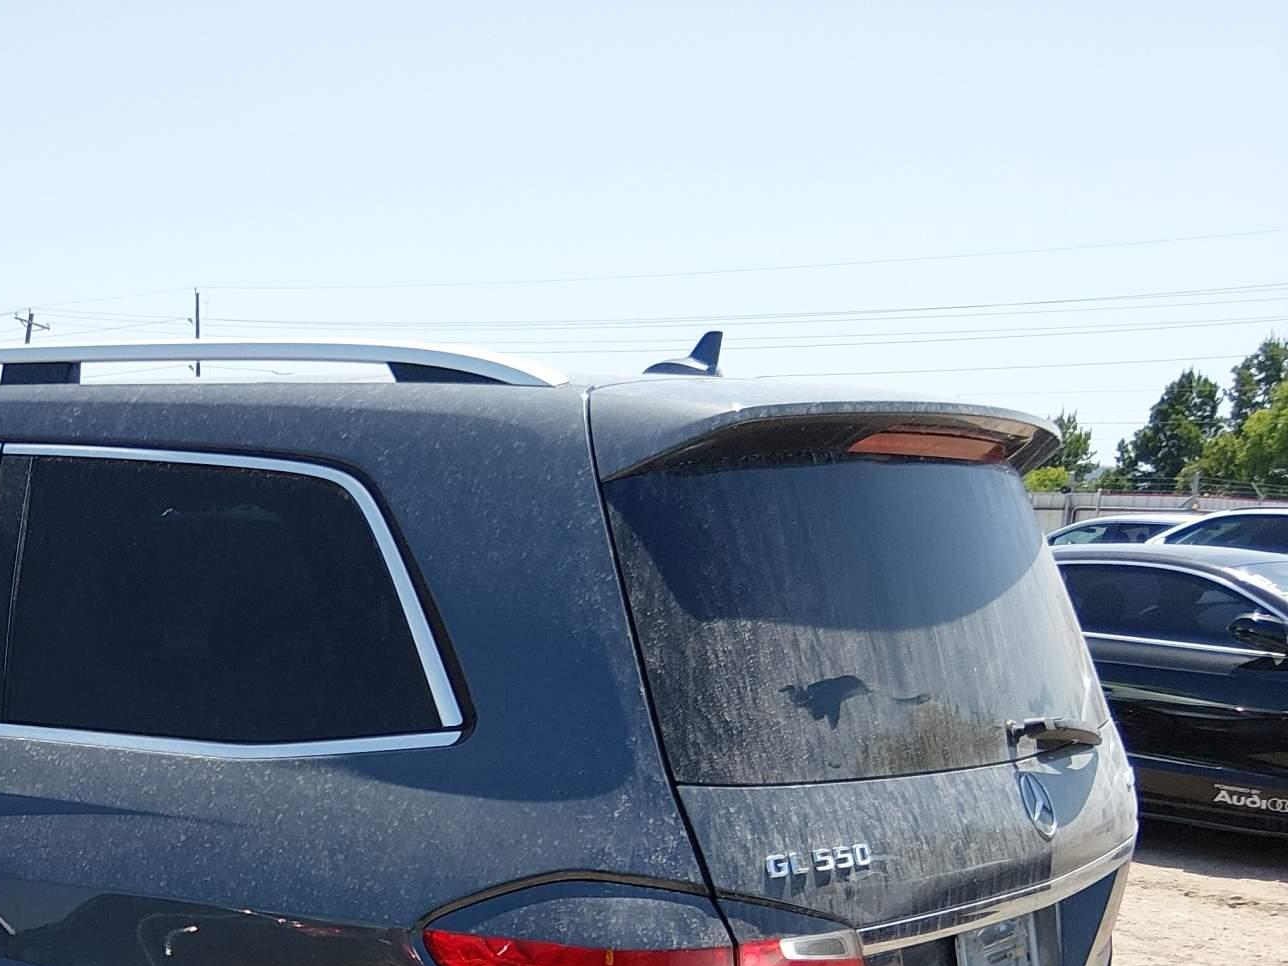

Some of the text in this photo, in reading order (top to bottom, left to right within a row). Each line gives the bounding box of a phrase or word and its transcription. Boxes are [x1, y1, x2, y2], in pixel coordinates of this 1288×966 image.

[1213, 790, 1268, 809] Audi
[765, 843, 872, 879] GL 550
